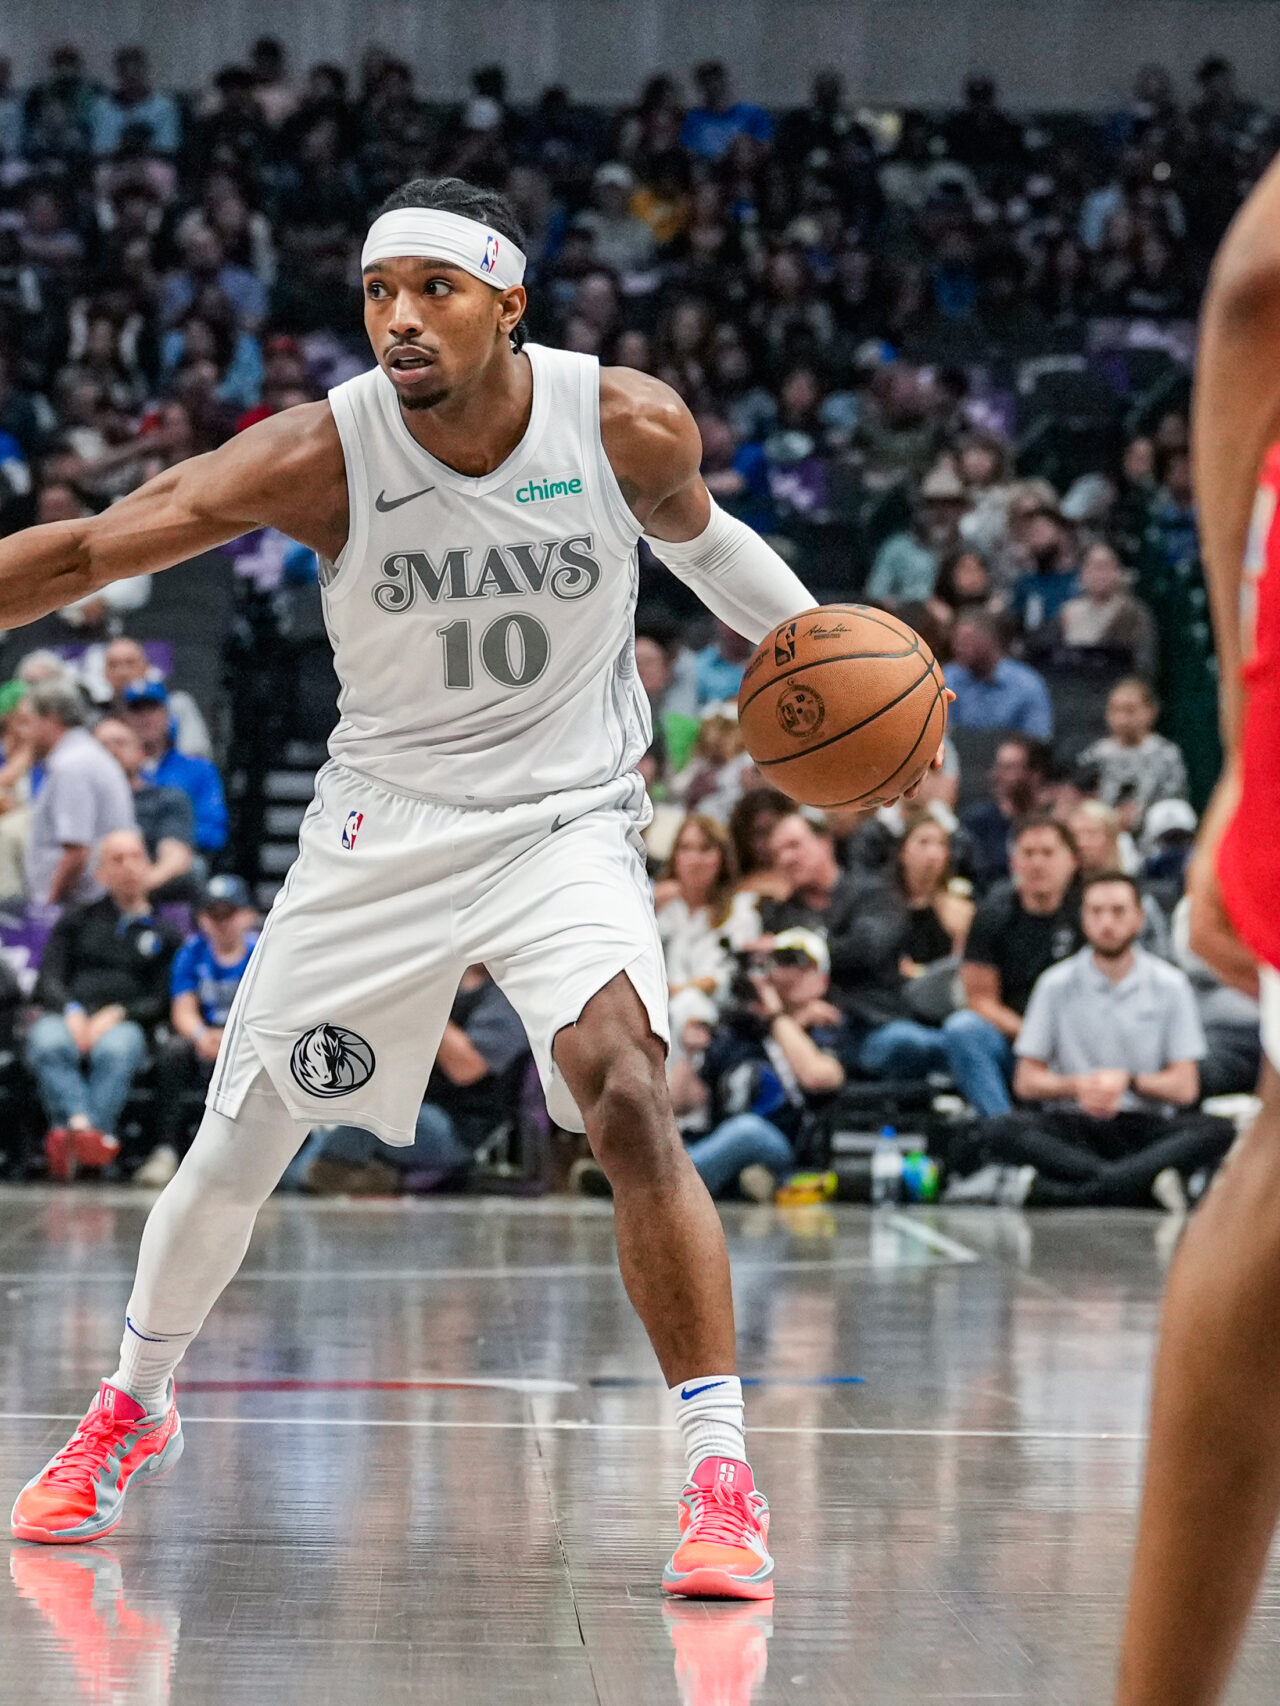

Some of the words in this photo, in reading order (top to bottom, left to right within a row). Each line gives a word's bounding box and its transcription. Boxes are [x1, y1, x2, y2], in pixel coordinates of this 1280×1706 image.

[515, 476, 583, 504] chime
[372, 532, 602, 615] MAVS
[436, 611, 551, 691] 10
